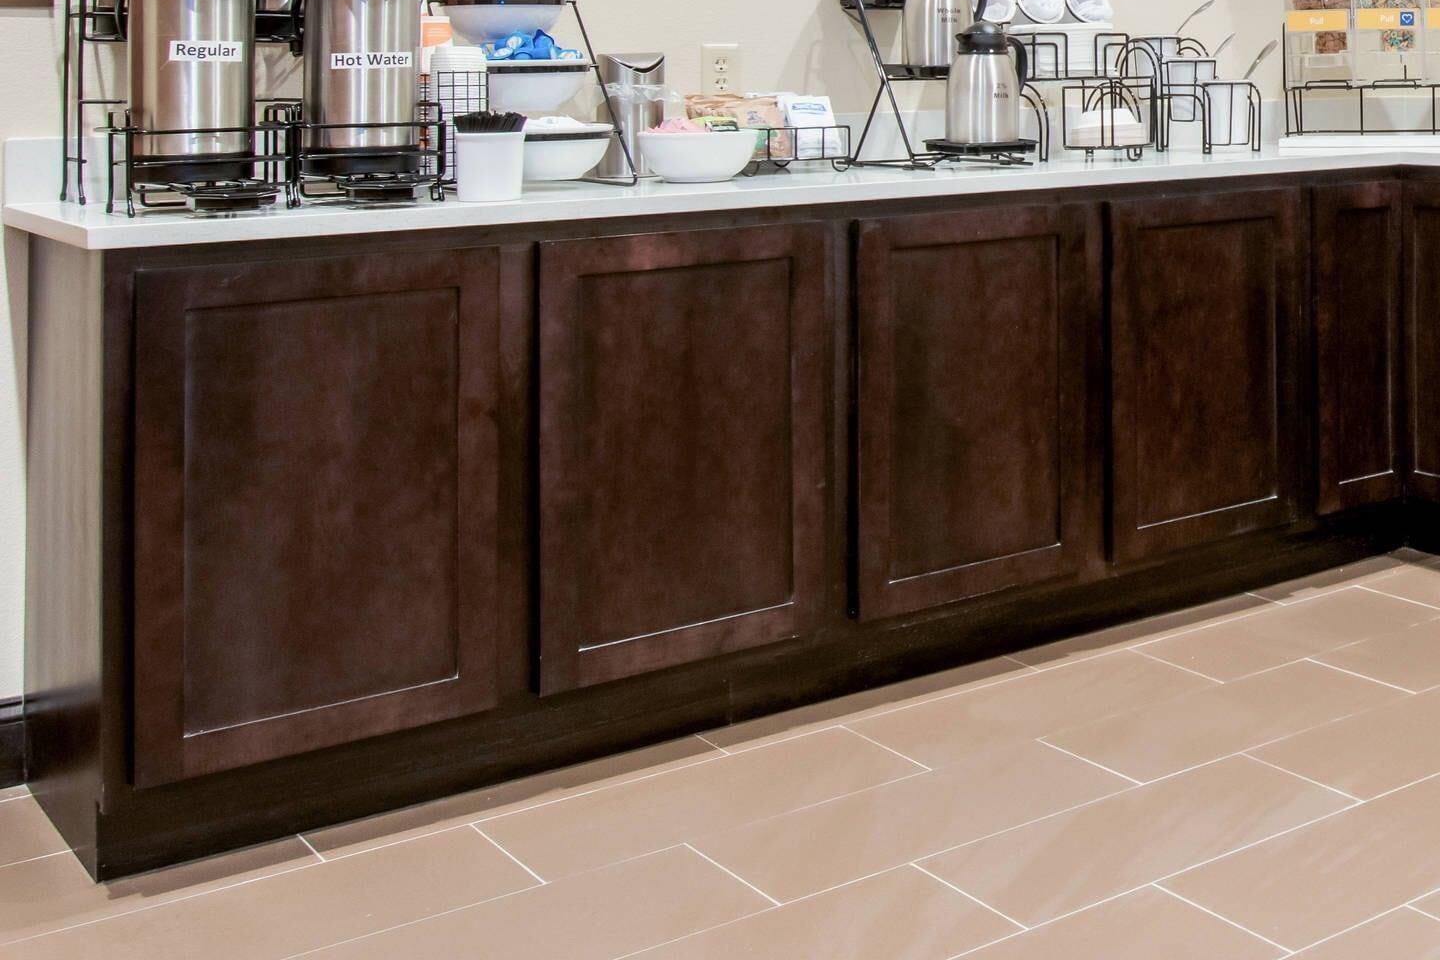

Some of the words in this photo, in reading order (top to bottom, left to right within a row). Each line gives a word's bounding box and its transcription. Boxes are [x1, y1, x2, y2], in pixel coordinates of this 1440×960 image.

[176, 43, 236, 60] Regular
[335, 54, 362, 66] Hot
[367, 53, 409, 66] Water
